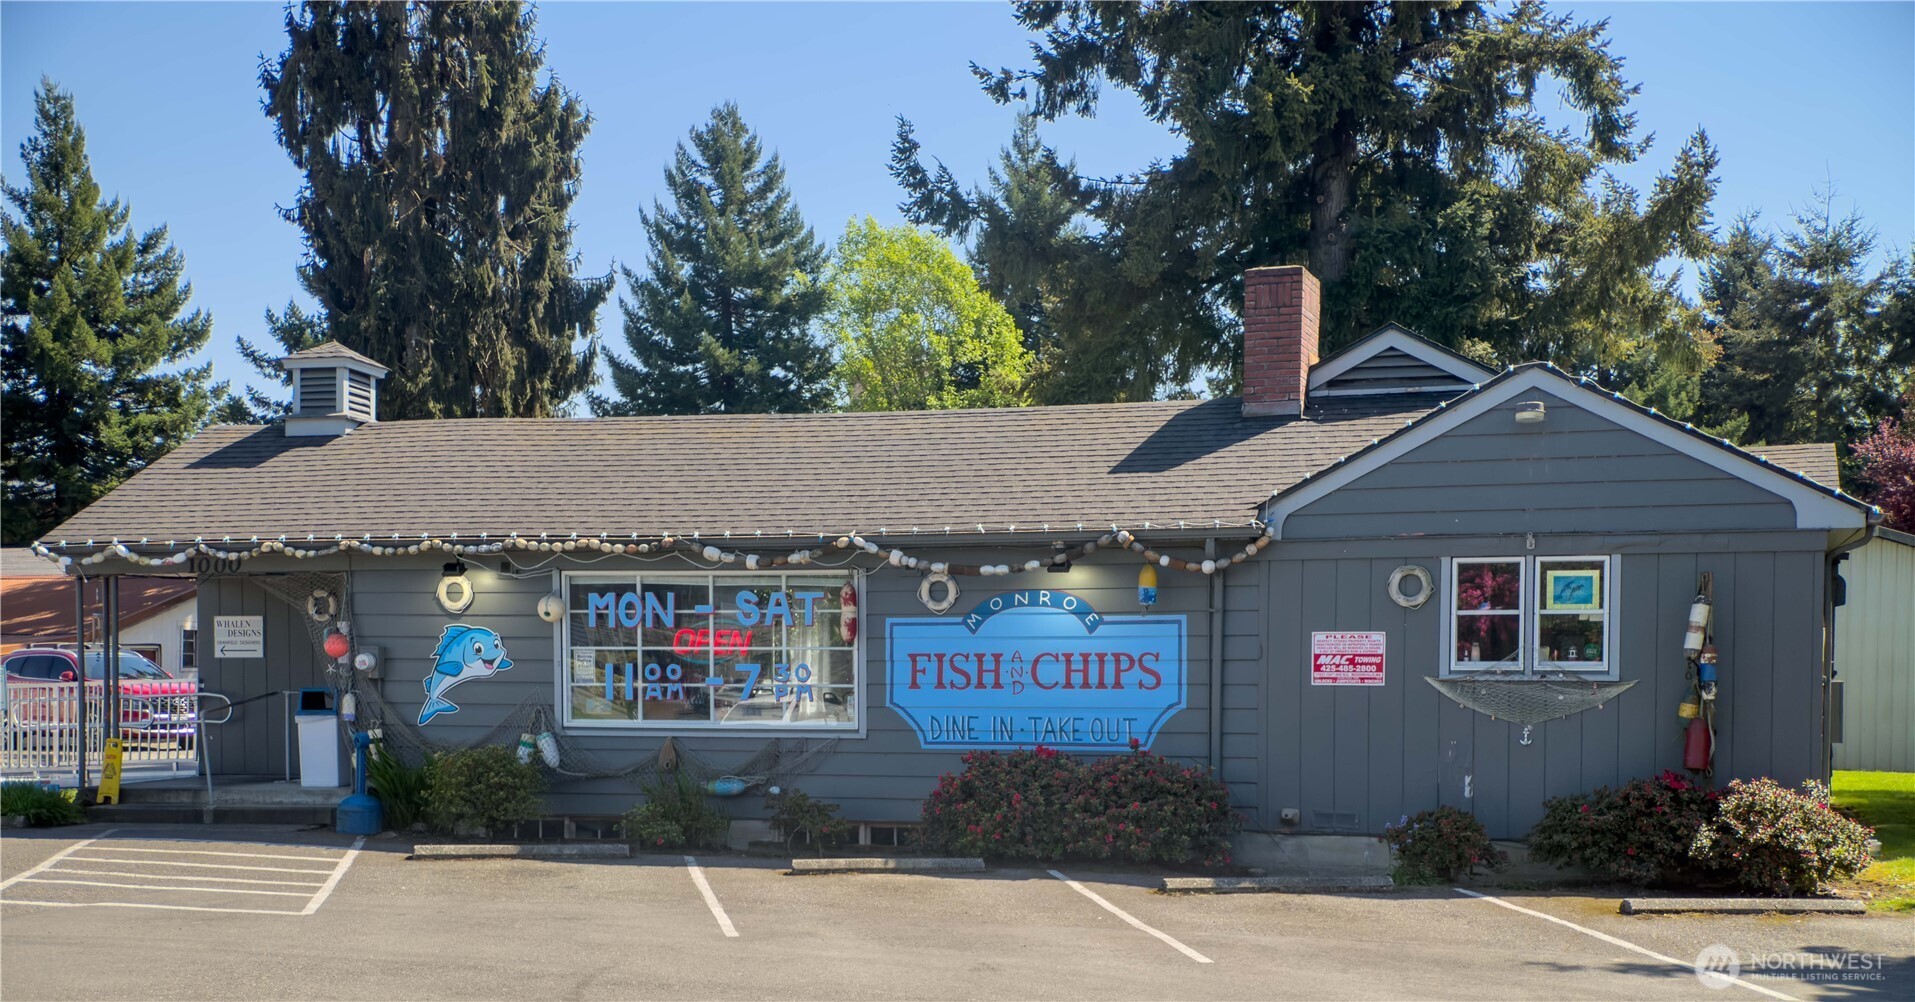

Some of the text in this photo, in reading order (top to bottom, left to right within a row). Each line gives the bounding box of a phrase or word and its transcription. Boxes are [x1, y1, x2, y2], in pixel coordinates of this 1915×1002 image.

[188, 556, 242, 574] 1000
[588, 591, 675, 629] MON
[735, 590, 825, 627] SAT
[966, 590, 1099, 630] MONROE
[216, 620, 251, 628] WHALEN
[227, 629, 262, 637] DESIGNS
[672, 628, 753, 656] OPEN
[1316, 655, 1353, 664] MAC
[1320, 664, 1376, 672] 425-485-2800
[605, 663, 635, 701] 11
[735, 663, 761, 701] 7
[774, 663, 812, 683] 30
[907, 650, 1162, 695] FISH AND CHIPS
[645, 683, 685, 701] AM
[775, 684, 814, 702] PM
[929, 714, 1138, 742] DINE IN TAKE OUT
